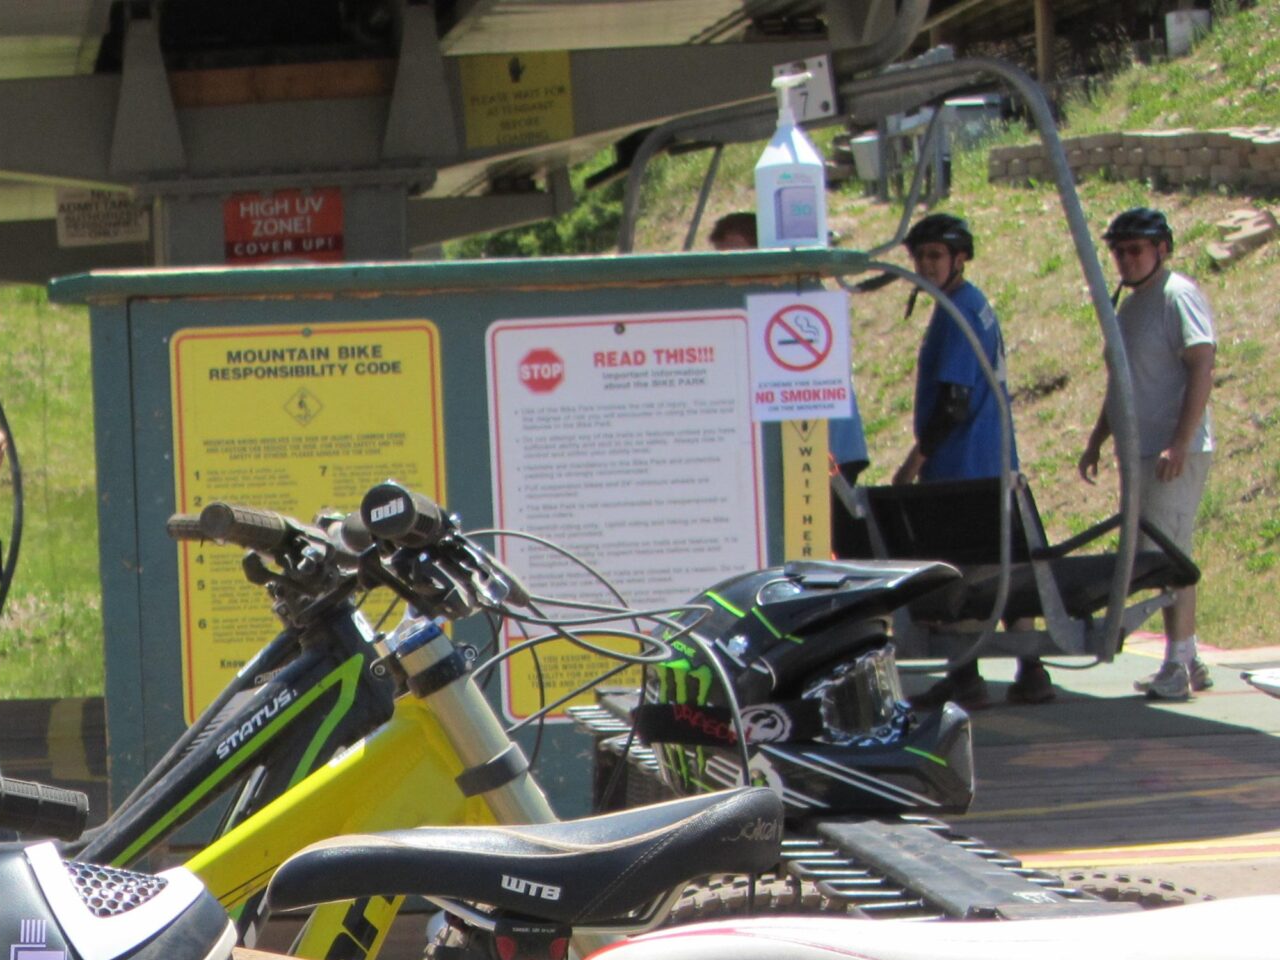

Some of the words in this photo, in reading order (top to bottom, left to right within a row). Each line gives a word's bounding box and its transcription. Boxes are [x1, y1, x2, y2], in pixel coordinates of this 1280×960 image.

[240, 197, 290, 218] HIGH
[295, 195, 323, 214] UV
[252, 217, 312, 237] ZONE!
[234, 239, 292, 256] COVER
[303, 237, 334, 250] UP!
[226, 347, 330, 365] MOUNTAIN
[338, 344, 382, 360] BIKE
[594, 350, 646, 368] READ
[654, 346, 714, 364] THIS!!!
[208, 363, 348, 381] RESPONSIBILITY
[354, 361, 402, 376] CODE
[520, 363, 562, 380] STOP
[755, 391, 775, 404] NO
[780, 387, 846, 404] SMOKING
[320, 466, 327, 476] 7
[799, 447, 812, 504] WAIT
[216, 688, 292, 760] STATUS
[501, 874, 561, 900] WTB
